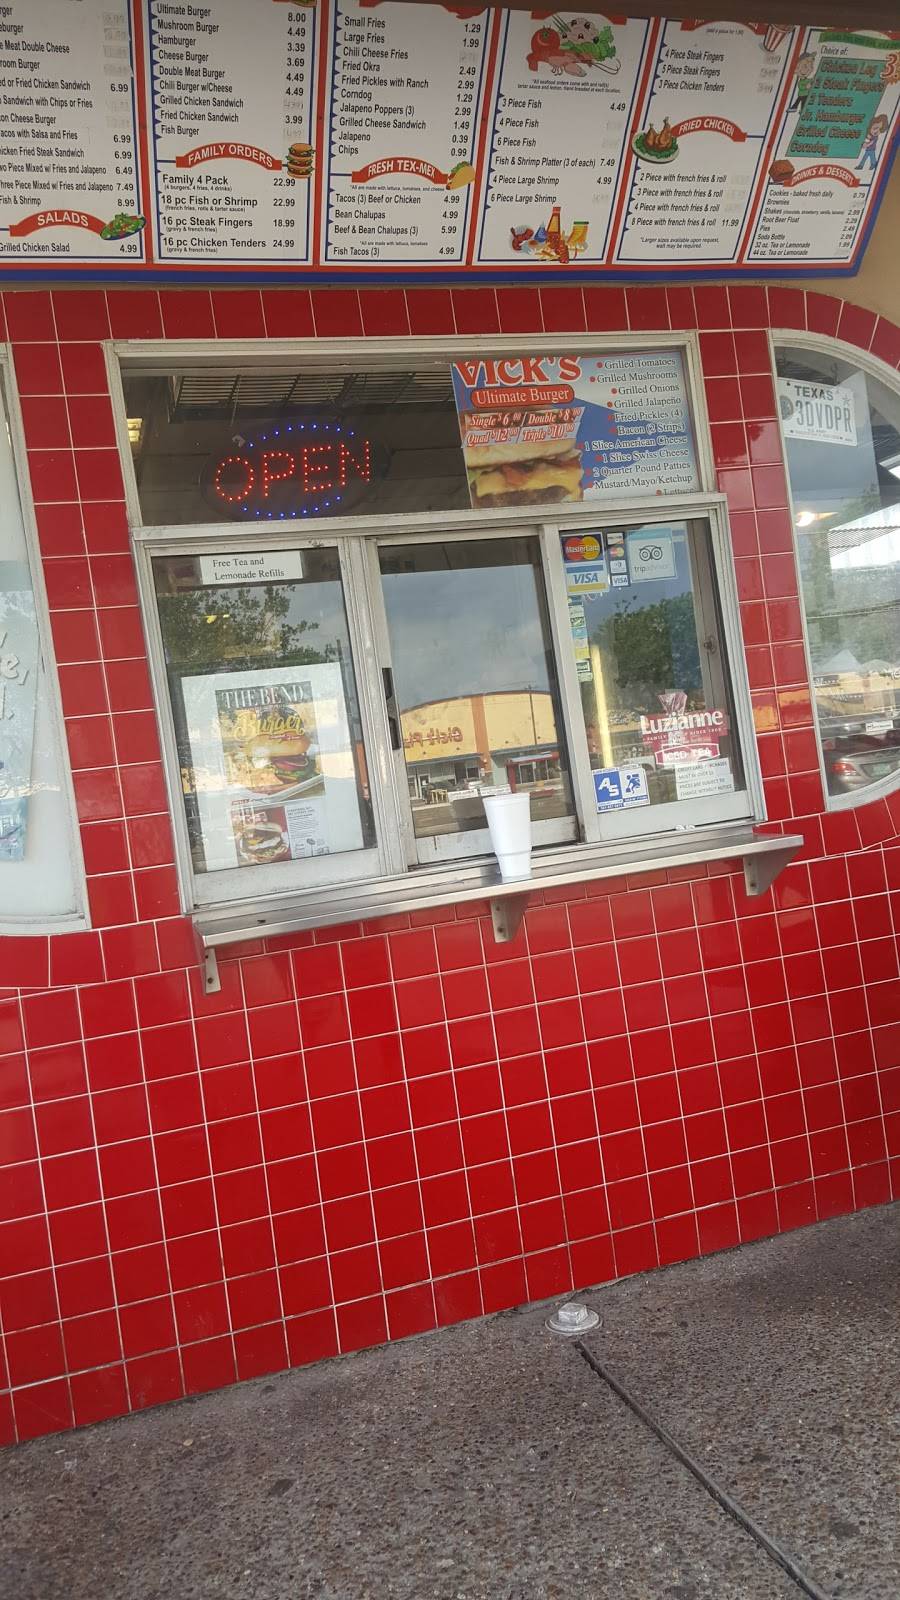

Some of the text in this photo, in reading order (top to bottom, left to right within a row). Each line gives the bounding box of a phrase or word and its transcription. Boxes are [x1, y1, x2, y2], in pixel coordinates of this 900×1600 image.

[157, 4, 211, 18] Ultimate Burger
[288, 13, 306, 22] 8.00
[344, 16, 386, 29] Small Fries
[157, 20, 219, 34] Mushroom Burger
[287, 28, 306, 37] 4.49
[464, 24, 481, 33] 1.29
[158, 35, 196, 48] Hamburger
[344, 31, 385, 44] Large Fries
[462, 39, 479, 48] 1.99
[287, 43, 306, 52] 3.39
[159, 50, 209, 63] Cheese Burger
[665, 49, 669, 58] 4
[670, 49, 686, 59] Piece
[703, 51, 725, 63] Fingers
[287, 58, 305, 67] 3.69
[159, 66, 225, 79] Double Meat Burger
[286, 73, 304, 82] 4.49
[33, 78, 59, 89] Chicken
[60, 80, 91, 91] Sandwich
[110, 83, 129, 93] 6.99
[341, 75, 429, 89] Fried Pickles with Ranch
[340, 89, 372, 101] Corndog
[456, 94, 473, 103] 1.29
[502, 98, 542, 109] 3 Piece Fish
[610, 102, 626, 112] 4.49
[678, 118, 735, 136] FRIED CHICKEN
[113, 135, 131, 144] 6.99
[188, 144, 273, 168] FAMILY ORDERS
[495, 156, 509, 166] Fish
[510, 157, 516, 165] &
[517, 157, 540, 168] Shrimp
[541, 157, 562, 167] Platter
[570, 158, 578, 167] of
[600, 158, 615, 167] 7.49
[368, 160, 436, 179] FRESH TEX-MEX
[162, 174, 228, 186] Family 4 Pack
[273, 178, 296, 187] 22.99
[161, 195, 173, 204] 18
[175, 197, 187, 207] pc
[189, 195, 210, 205] Fish
[224, 196, 258, 208] Shrimp
[273, 198, 296, 207] 22.99
[336, 193, 356, 203] Tacos
[357, 194, 367, 205] (3)
[368, 195, 384, 204] Beef
[394, 195, 421, 204] Chicken
[443, 196, 460, 204] 4.99
[37, 212, 89, 227] SALADS
[335, 210, 386, 220] Bean Chalupas
[162, 216, 253, 229] 16 pc Steak Fingers
[273, 219, 295, 228] 18.99
[721, 219, 739, 228] 11.99
[22, 243, 49, 254] Chicken
[51, 243, 70, 253] Salad
[163, 237, 267, 249] 16 pc Chicken Tenders
[272, 240, 295, 248] 24.99
[120, 245, 137, 254] 4.99
[604, 359, 676, 369] Grilled Tomatoes
[454, 356, 582, 386] VICK'S
[597, 371, 678, 383] Grilled Mushrooms
[618, 384, 680, 394] Grilled Onions
[794, 385, 834, 401] TEXAS
[476, 388, 569, 406] Ultimate Burger
[614, 400, 644, 409] Grilled
[470, 415, 496, 428] Single
[528, 412, 557, 425] Double
[615, 409, 683, 422] Fried Pickles (4)
[618, 424, 645, 435] Bacon
[467, 434, 490, 447] Quad
[523, 429, 546, 442] Triple
[585, 435, 687, 451] 1 Slice American Cheese
[603, 448, 689, 463] 1 Slice Swiss Cheese
[215, 439, 372, 501] OPEN
[593, 461, 691, 477] 2 Quarter Pound Patties
[594, 474, 692, 489] Mustard/Mayo/Ketchup
[213, 556, 265, 568] Free Tea and
[215, 568, 285, 581] Lemonade Refills
[573, 573, 599, 584] VISA
[222, 685, 304, 709] THE BEND
[640, 710, 724, 735] Luzianne
